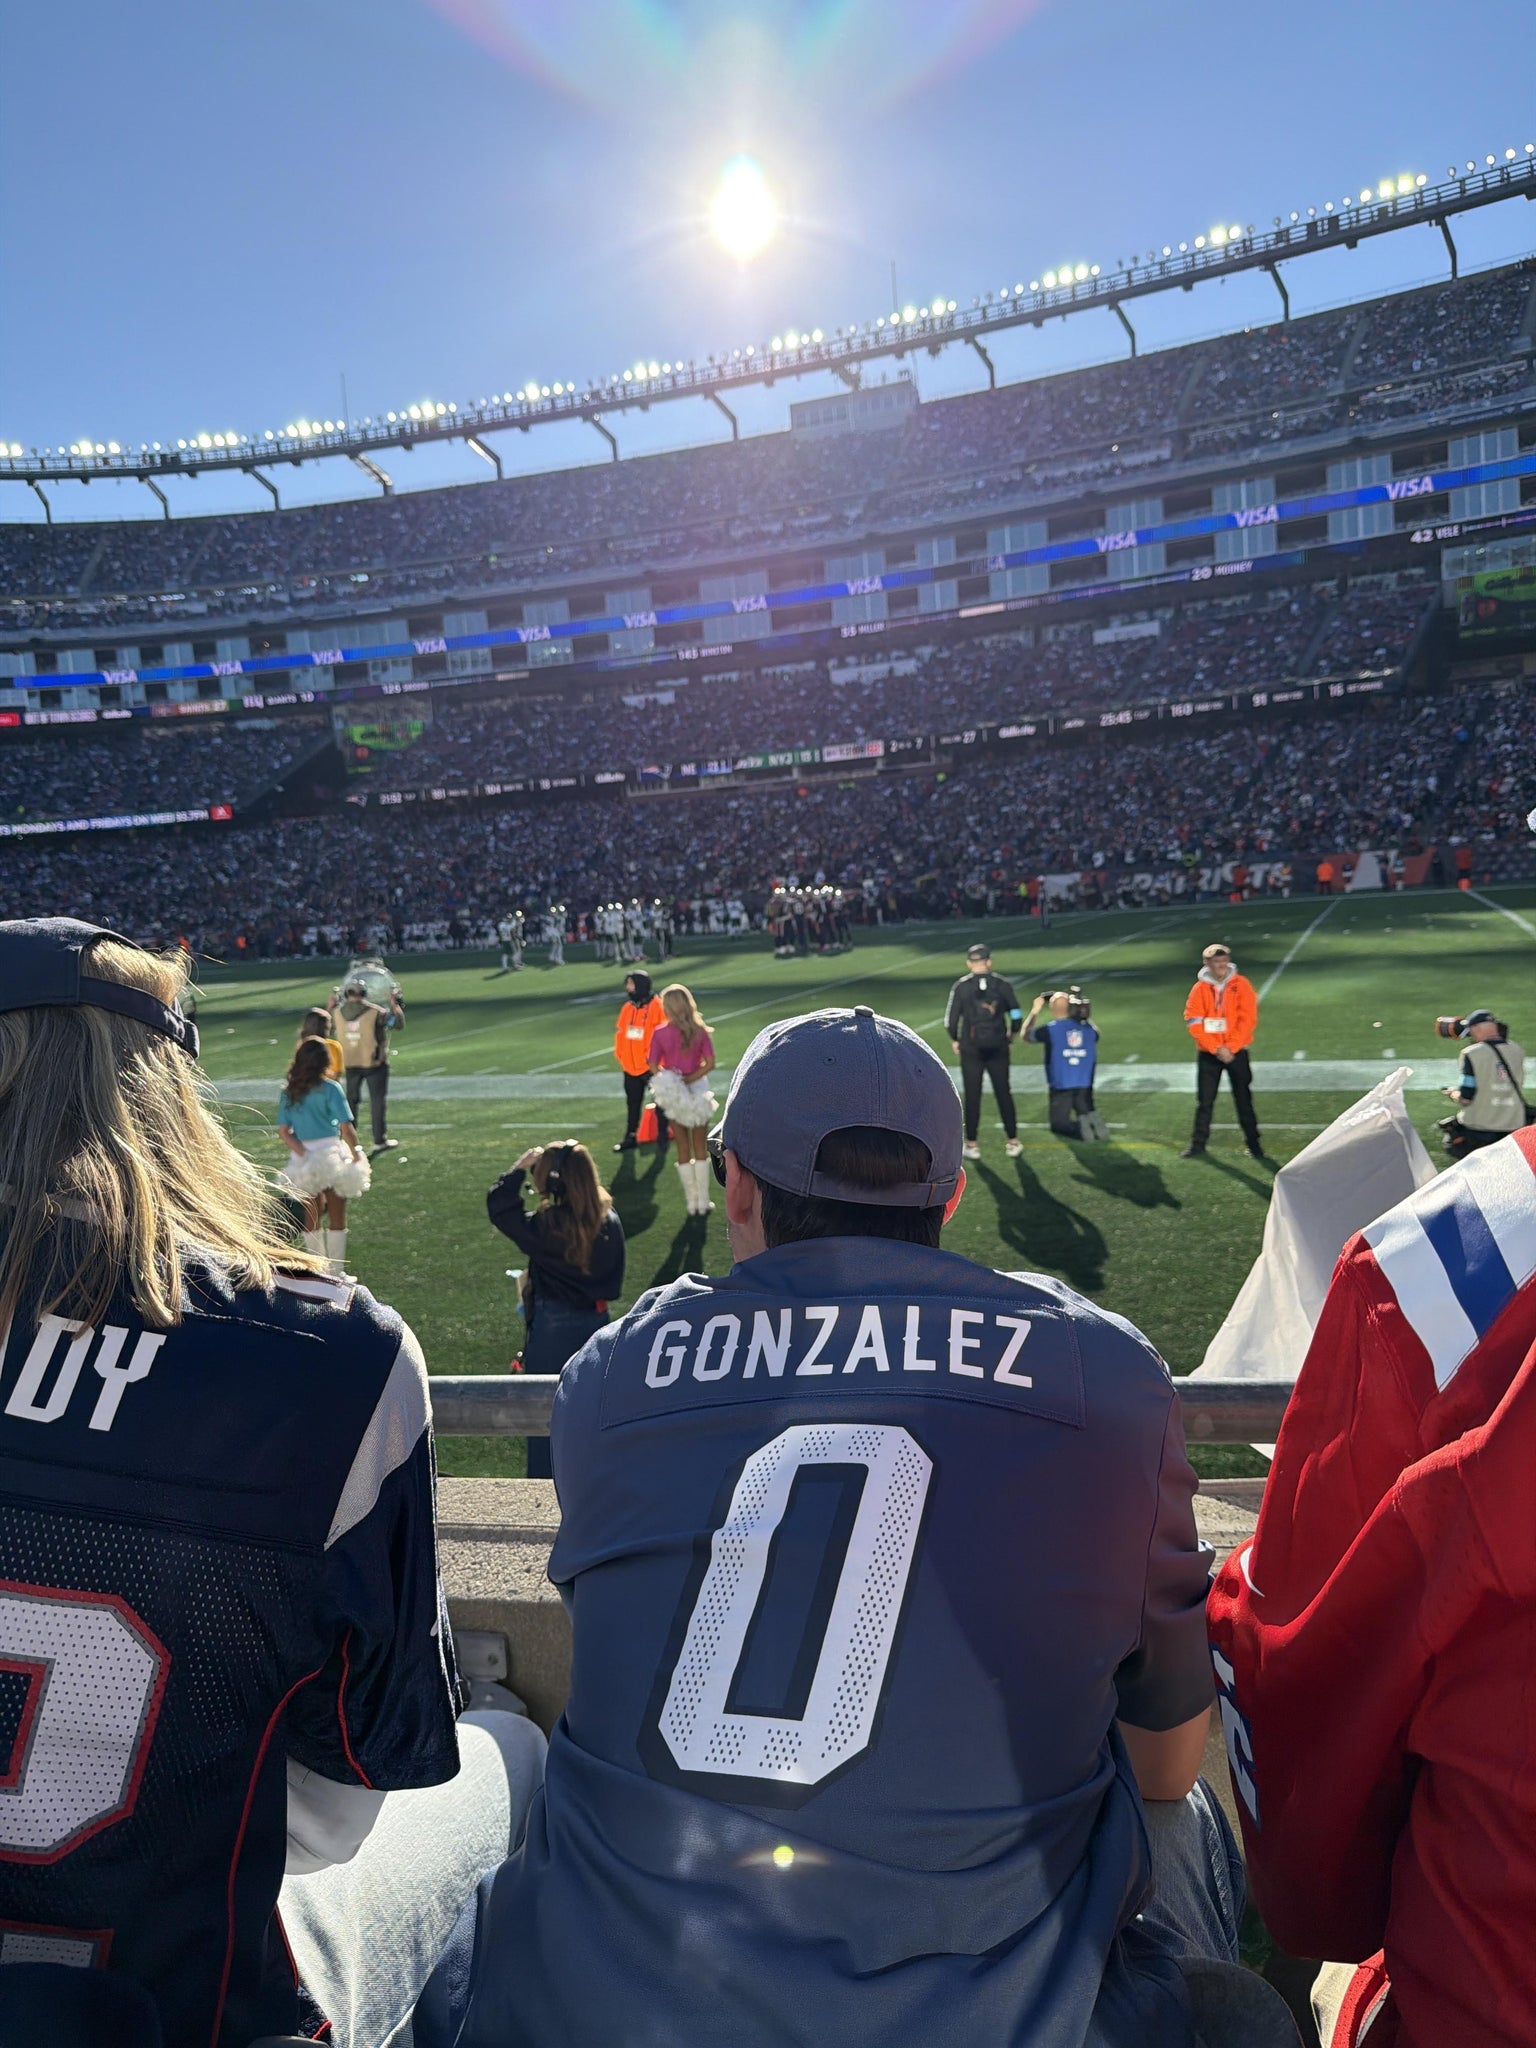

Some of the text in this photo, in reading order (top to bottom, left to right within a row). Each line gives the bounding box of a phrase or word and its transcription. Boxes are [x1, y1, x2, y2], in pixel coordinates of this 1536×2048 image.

[1385, 476, 1434, 501] VISA
[1233, 504, 1279, 528] VISA
[1095, 531, 1138, 552] VISA
[1410, 524, 1460, 544] 42 VELE
[1192, 566, 1213, 582] 20
[846, 576, 882, 595] VISA
[733, 596, 767, 613] VISA
[623, 612, 657, 628] VISA
[517, 626, 551, 643] VISA
[414, 638, 448, 654] VISA
[312, 650, 345, 665] VISA
[210, 660, 243, 676] VISA
[103, 669, 138, 685] VISA
[1100, 710, 1133, 727] 25:45
[644, 1304, 1033, 1389] GONZALEZ
[0, 1306, 168, 1432] DY
[657, 1422, 934, 1786] 0
